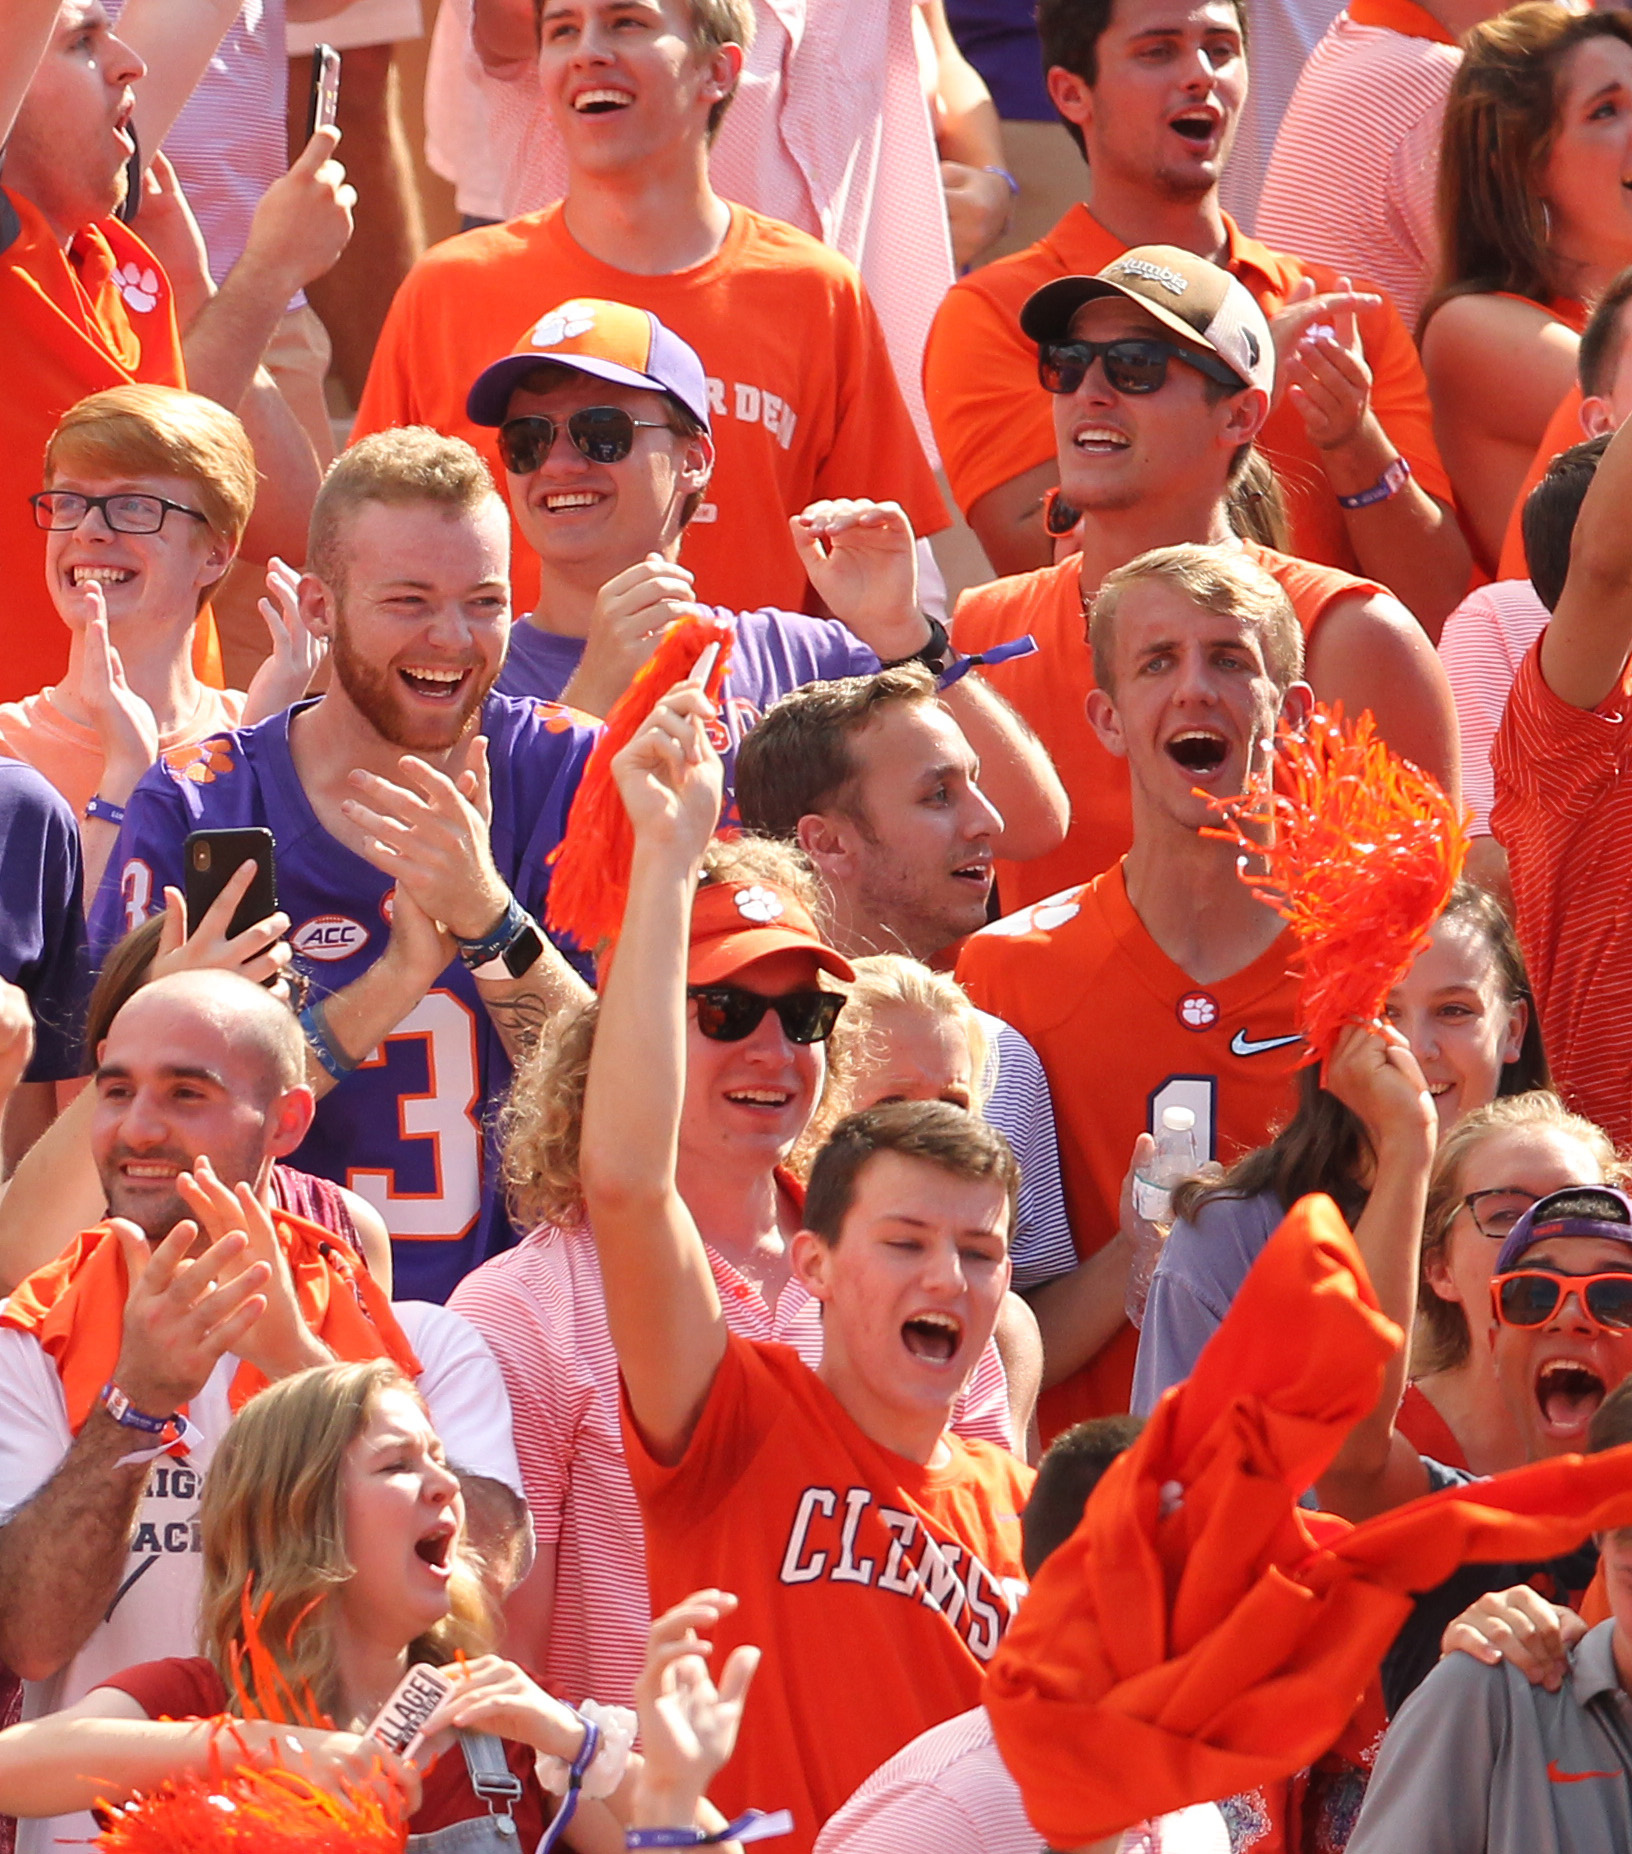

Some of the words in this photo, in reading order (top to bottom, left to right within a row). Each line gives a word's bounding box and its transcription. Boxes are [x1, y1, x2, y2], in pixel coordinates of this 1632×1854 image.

[302, 925, 357, 946] ACC
[345, 987, 484, 1241] 3
[370, 1675, 432, 1750] ILLAGE
